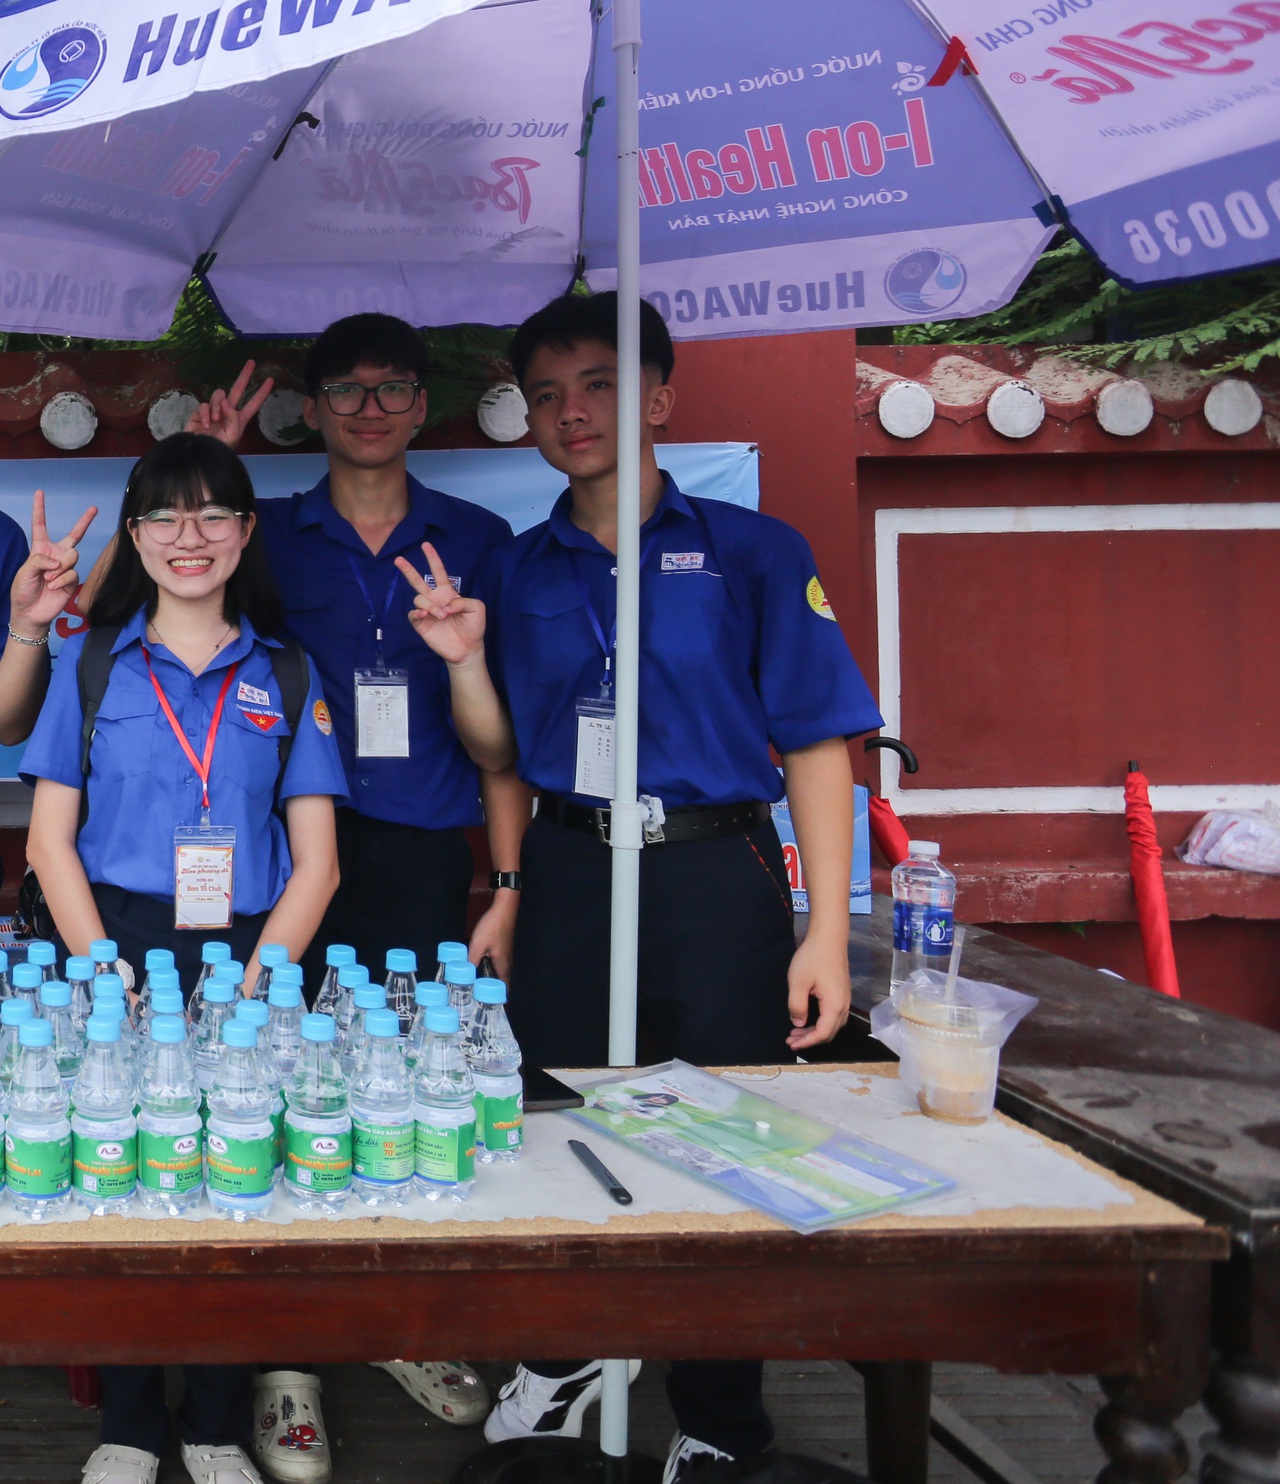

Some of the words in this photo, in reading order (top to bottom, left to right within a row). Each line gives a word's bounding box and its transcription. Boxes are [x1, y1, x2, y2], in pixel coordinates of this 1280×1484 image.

[12, 45, 30, 60] CÔNG
[31, 36, 40, 46] TY
[122, 0, 410, 83] HueW
